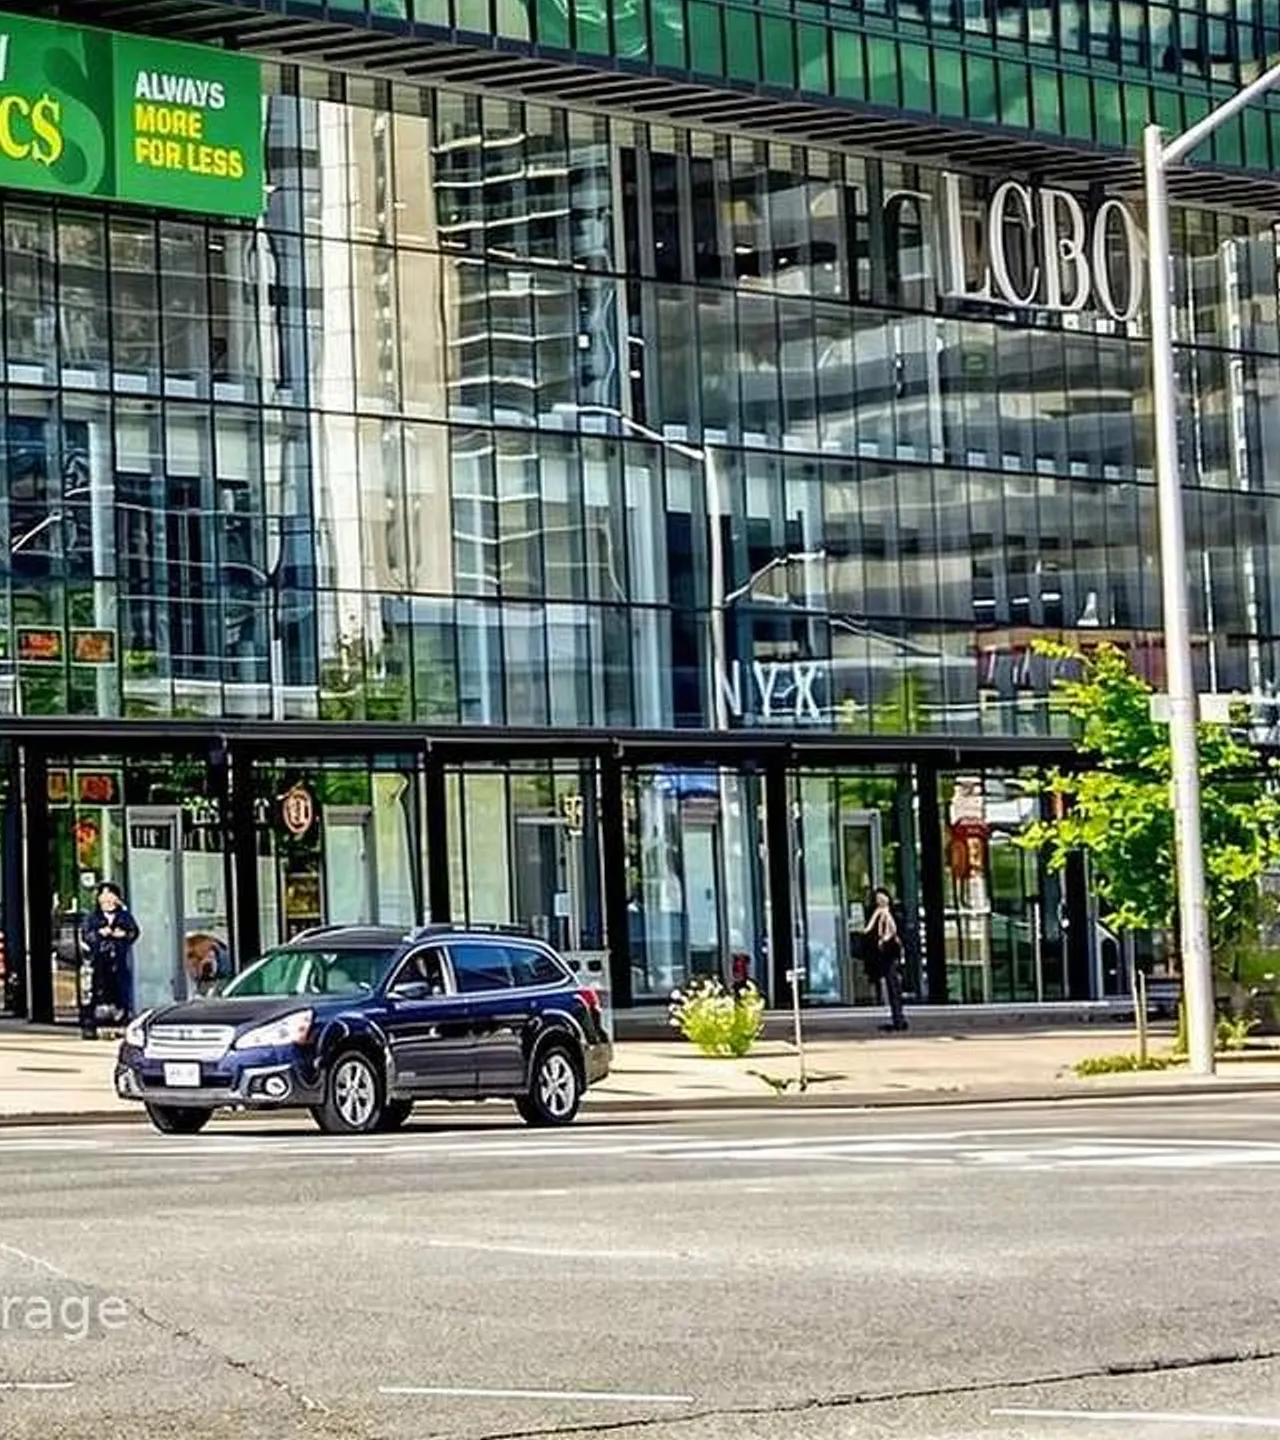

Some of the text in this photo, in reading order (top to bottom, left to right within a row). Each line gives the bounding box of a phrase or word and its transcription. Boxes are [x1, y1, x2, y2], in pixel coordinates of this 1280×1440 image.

[135, 70, 225, 109] ALWAYS
[135, 103, 202, 140] MORE
[135, 137, 244, 178] FOR LESS
[938, 170, 1145, 322] LCBO
